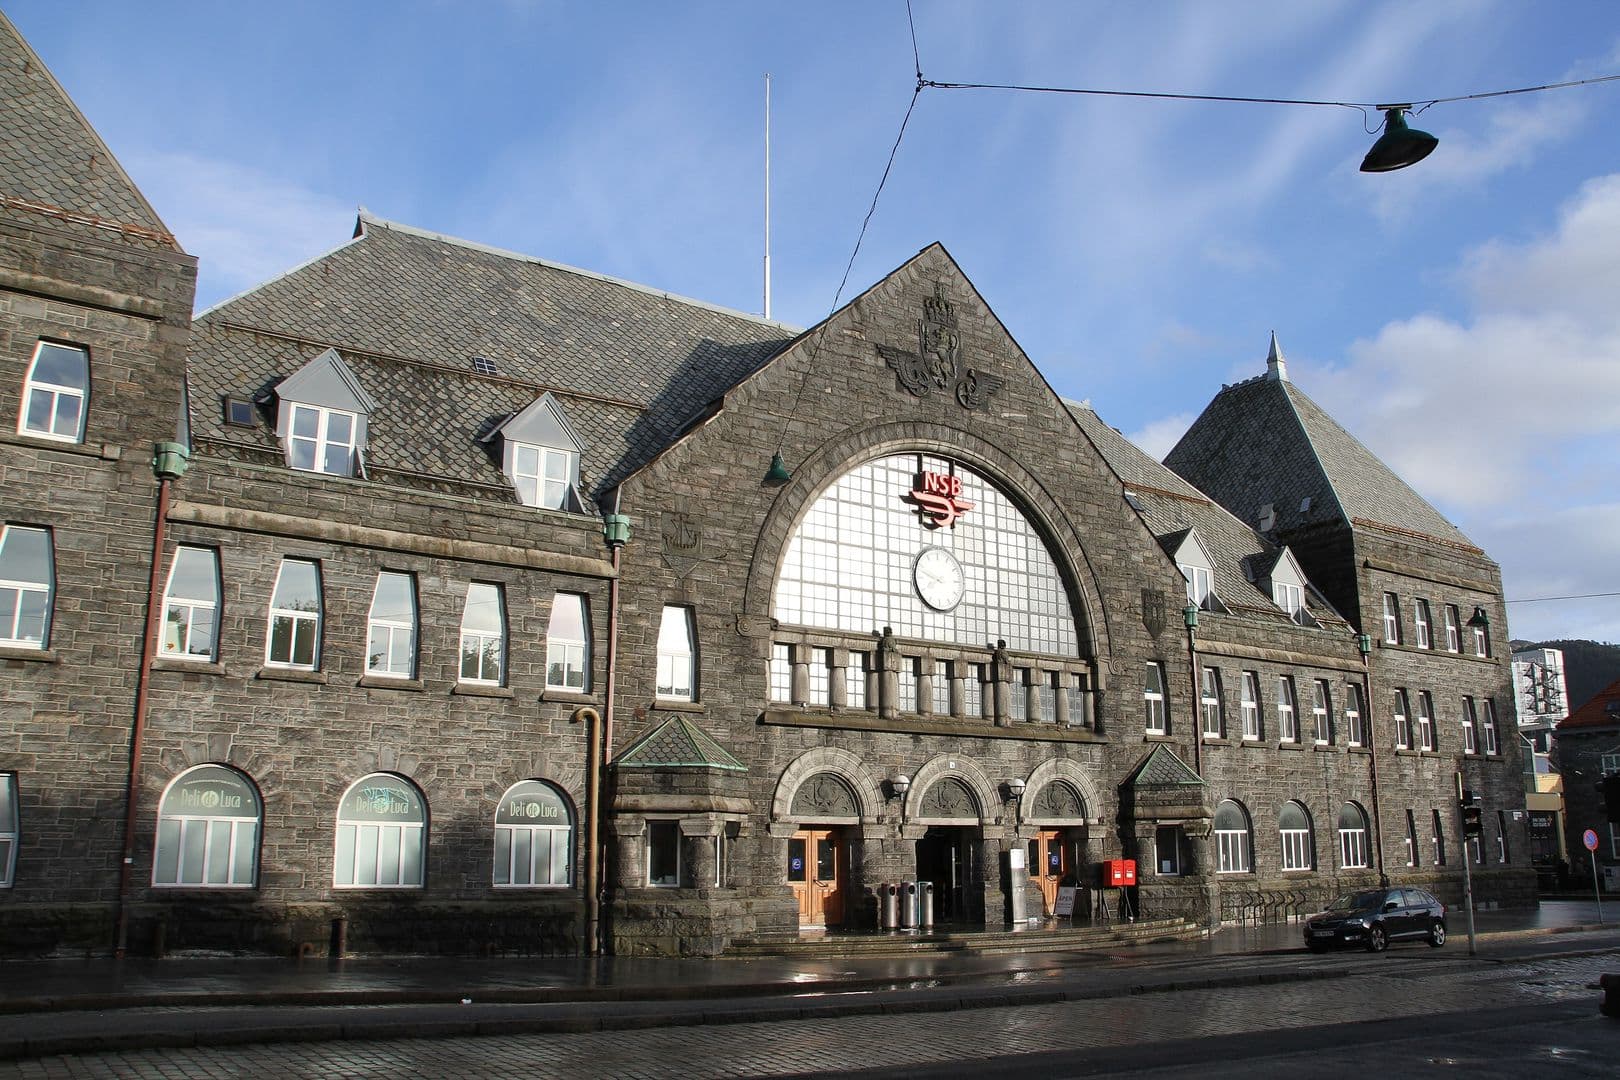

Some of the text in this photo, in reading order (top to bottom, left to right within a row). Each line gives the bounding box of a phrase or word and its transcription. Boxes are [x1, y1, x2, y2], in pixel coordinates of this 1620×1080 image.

[925, 471, 962, 496] NSB
[182, 788, 200, 808] Deli
[221, 790, 240, 808] Luca
[510, 801, 558, 818] Deli de Luca
